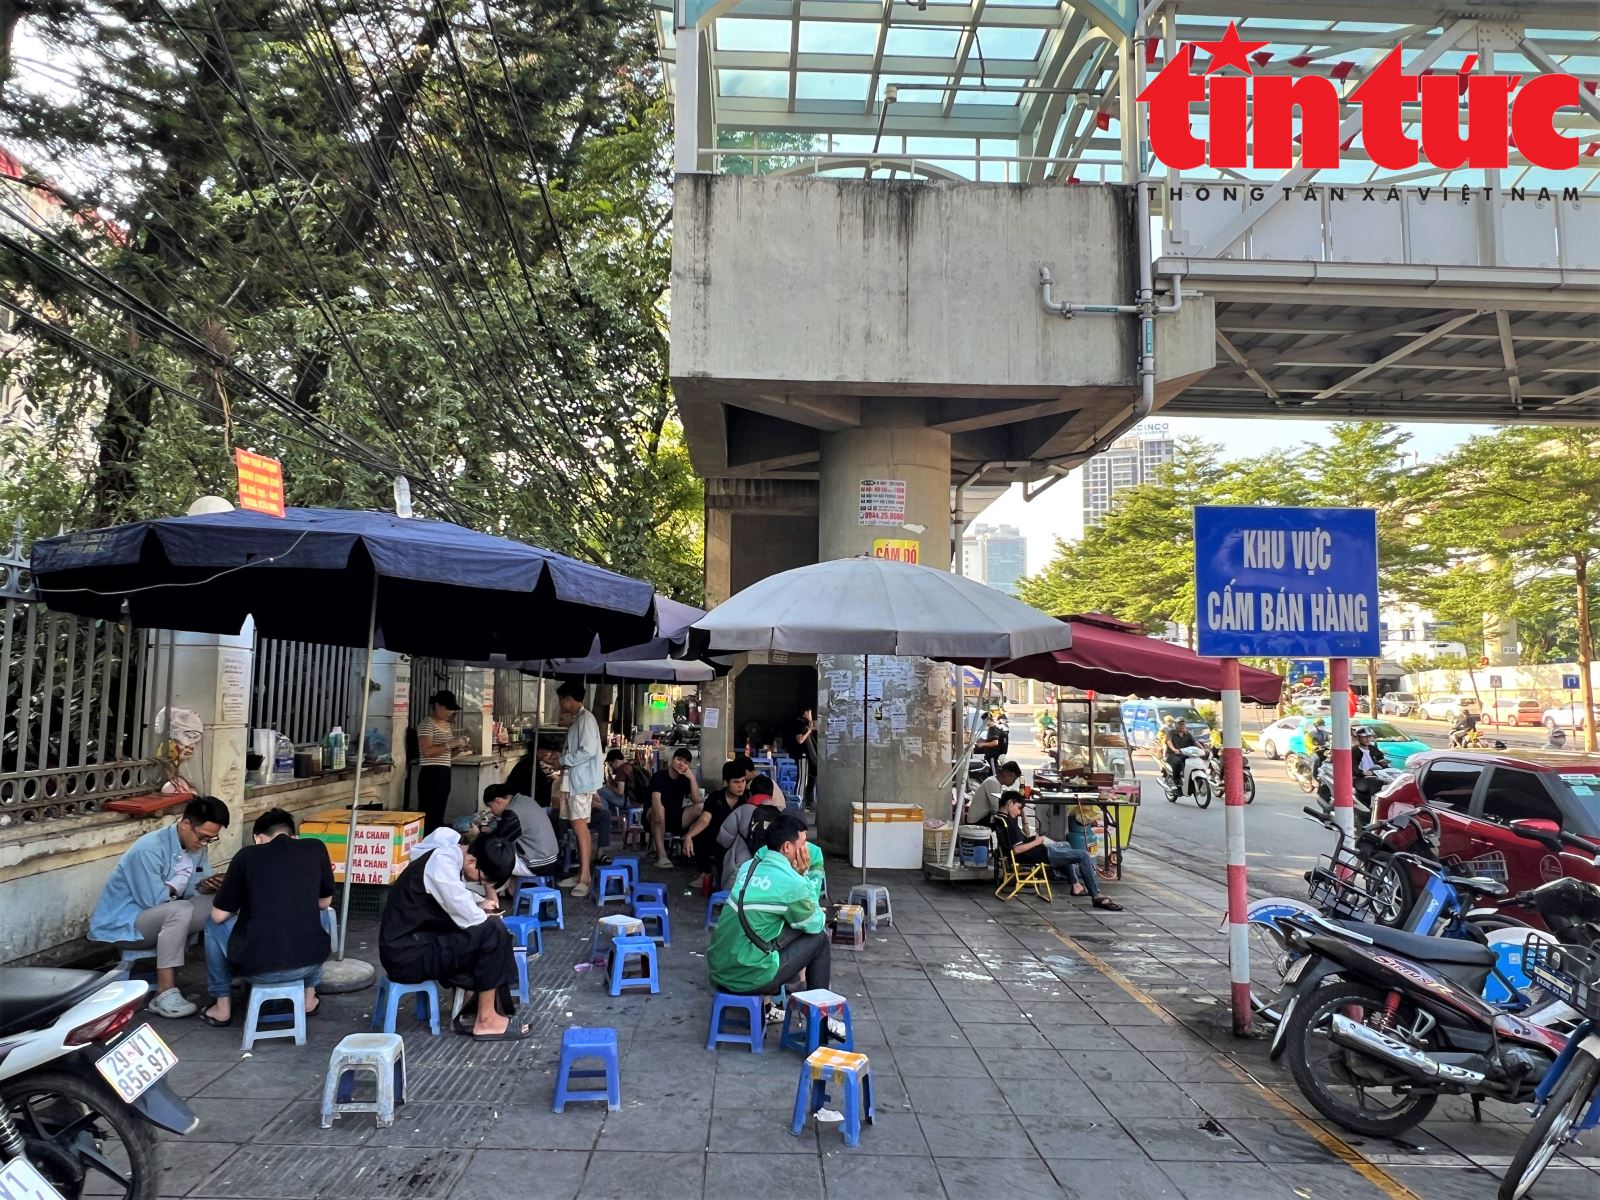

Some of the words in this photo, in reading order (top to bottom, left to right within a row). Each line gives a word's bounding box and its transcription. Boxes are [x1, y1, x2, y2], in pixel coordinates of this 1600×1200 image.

[1243, 529, 1285, 570] KHU
[1291, 526, 1332, 576] VỰC
[1207, 578, 1255, 631] CẤM
[1260, 586, 1305, 632] BÁN
[1310, 586, 1369, 633] HÀNG
[118, 1047, 169, 1097] 856.97
